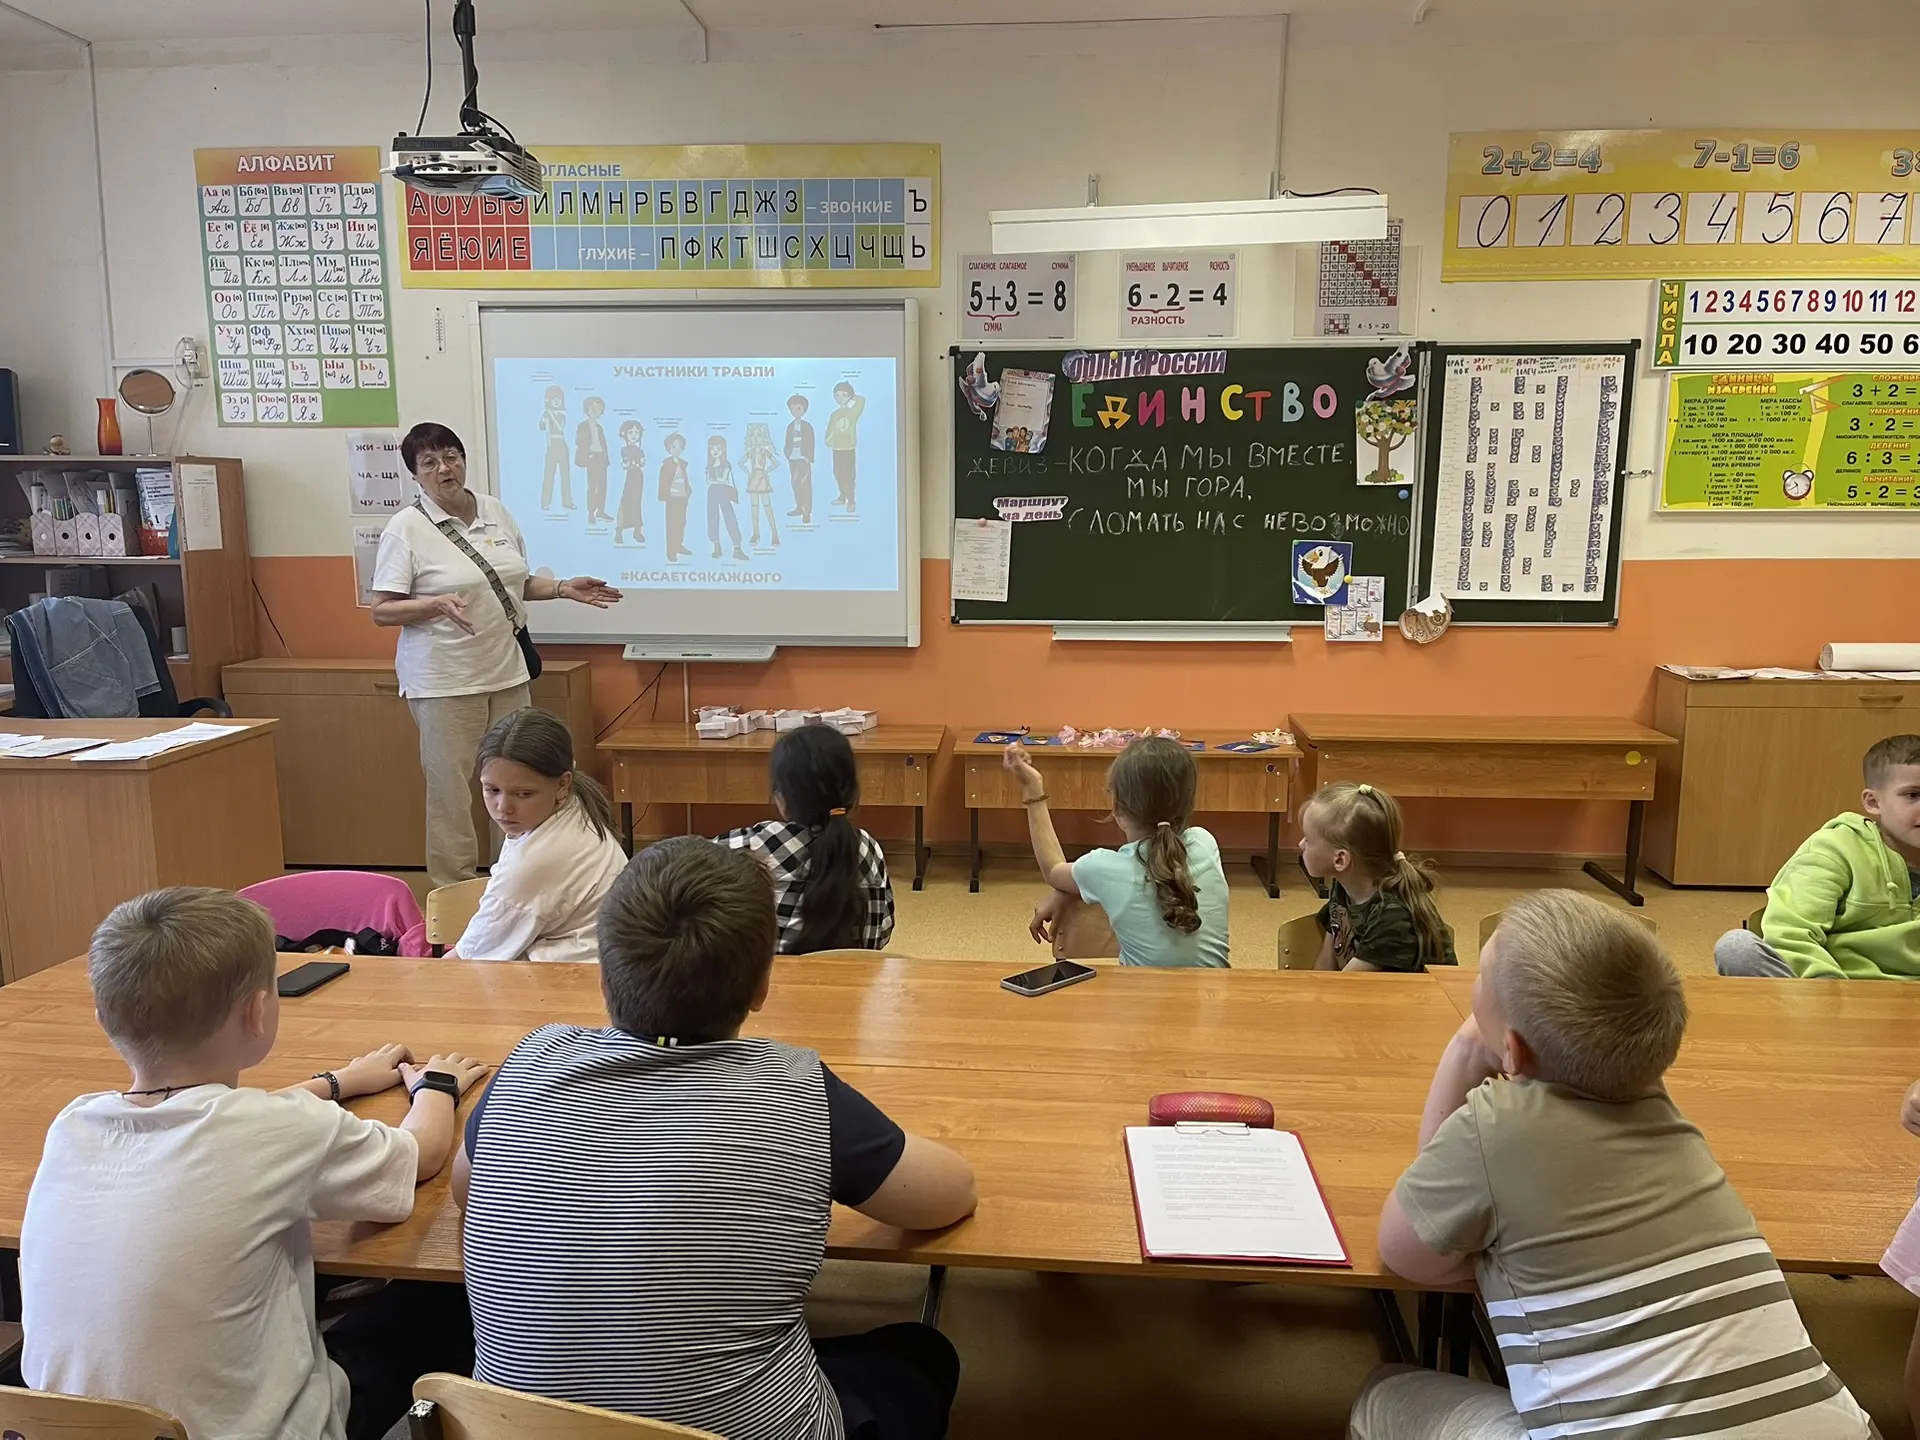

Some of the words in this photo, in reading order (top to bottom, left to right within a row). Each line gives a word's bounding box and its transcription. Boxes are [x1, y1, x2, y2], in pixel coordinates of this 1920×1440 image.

[237, 154, 335, 173] АЛФАВИТ
[1482, 143, 1602, 174] 2+2=4
[1695, 140, 1799, 172] 7-1=6
[820, 201, 892, 213] ЗВОНКИЕ
[909, 189, 927, 212] Ъ
[1594, 194, 1625, 246] 2
[1648, 193, 1681, 244] 3
[1707, 194, 1736, 243] 4
[1762, 192, 1794, 243] 5
[1818, 192, 1852, 243] 6
[578, 248, 636, 260] ГЛУХИЕ
[969, 262, 996, 270] СЛАГАЕМОЕ
[1000, 262, 1027, 270] СЛАГАЕМОЕ
[1052, 262, 1068, 270] СУММА
[1126, 262, 1156, 272] УМЕНЬШАЕМОЕ
[1162, 262, 1189, 272] ВЫЧИТАЕМОЕ
[1210, 262, 1230, 270] РАЗНОСТЬ
[1054, 281, 1066, 311] 8
[1128, 283, 1142, 306] 6
[1166, 283, 1180, 306] 2
[1212, 283, 1227, 306] 4
[1689, 290, 1699, 312] 1
[1705, 290, 1718, 312] 2
[1722, 290, 1735, 312] 3
[1739, 290, 1752, 312] 4
[1757, 290, 1769, 312] 5
[1773, 290, 1786, 312] 6
[1791, 290, 1803, 312] 7
[1807, 290, 1819, 312] 8
[1824, 290, 1836, 312] 9
[1842, 290, 1863, 312] 10
[1869, 290, 1887, 312] 11
[1894, 290, 1916, 312] 12
[984, 323, 1002, 332] СУММА
[1132, 316, 1184, 324] РАЗНОСТЬ
[1658, 283, 1679, 365] ЧИСЛА
[1684, 333, 1718, 355] 10
[1727, 333, 1762, 355] 20
[1772, 333, 1806, 355] 30
[1815, 333, 1850, 355] 40
[1860, 333, 1893, 355] 50
[613, 366, 708, 378] УЧАСТНИКИ
[713, 366, 775, 378] ТРАВЛИ
[1712, 373, 1775, 384] ЕДИНИЦЫ
[1708, 385, 1777, 395] ИЗМЕРЕНИЯ
[1071, 381, 1338, 430] ЕДИНСТВО
[1181, 444, 1232, 469] МЫ
[1870, 442, 1911, 450] ДЕЛЕНИЕ
[1127, 476, 1168, 498] МЫ
[1023, 509, 1062, 521] день
[1197, 511, 1245, 535] НАС
[620, 570, 782, 584] #КАСАЕТСЯКАЖДОГО
